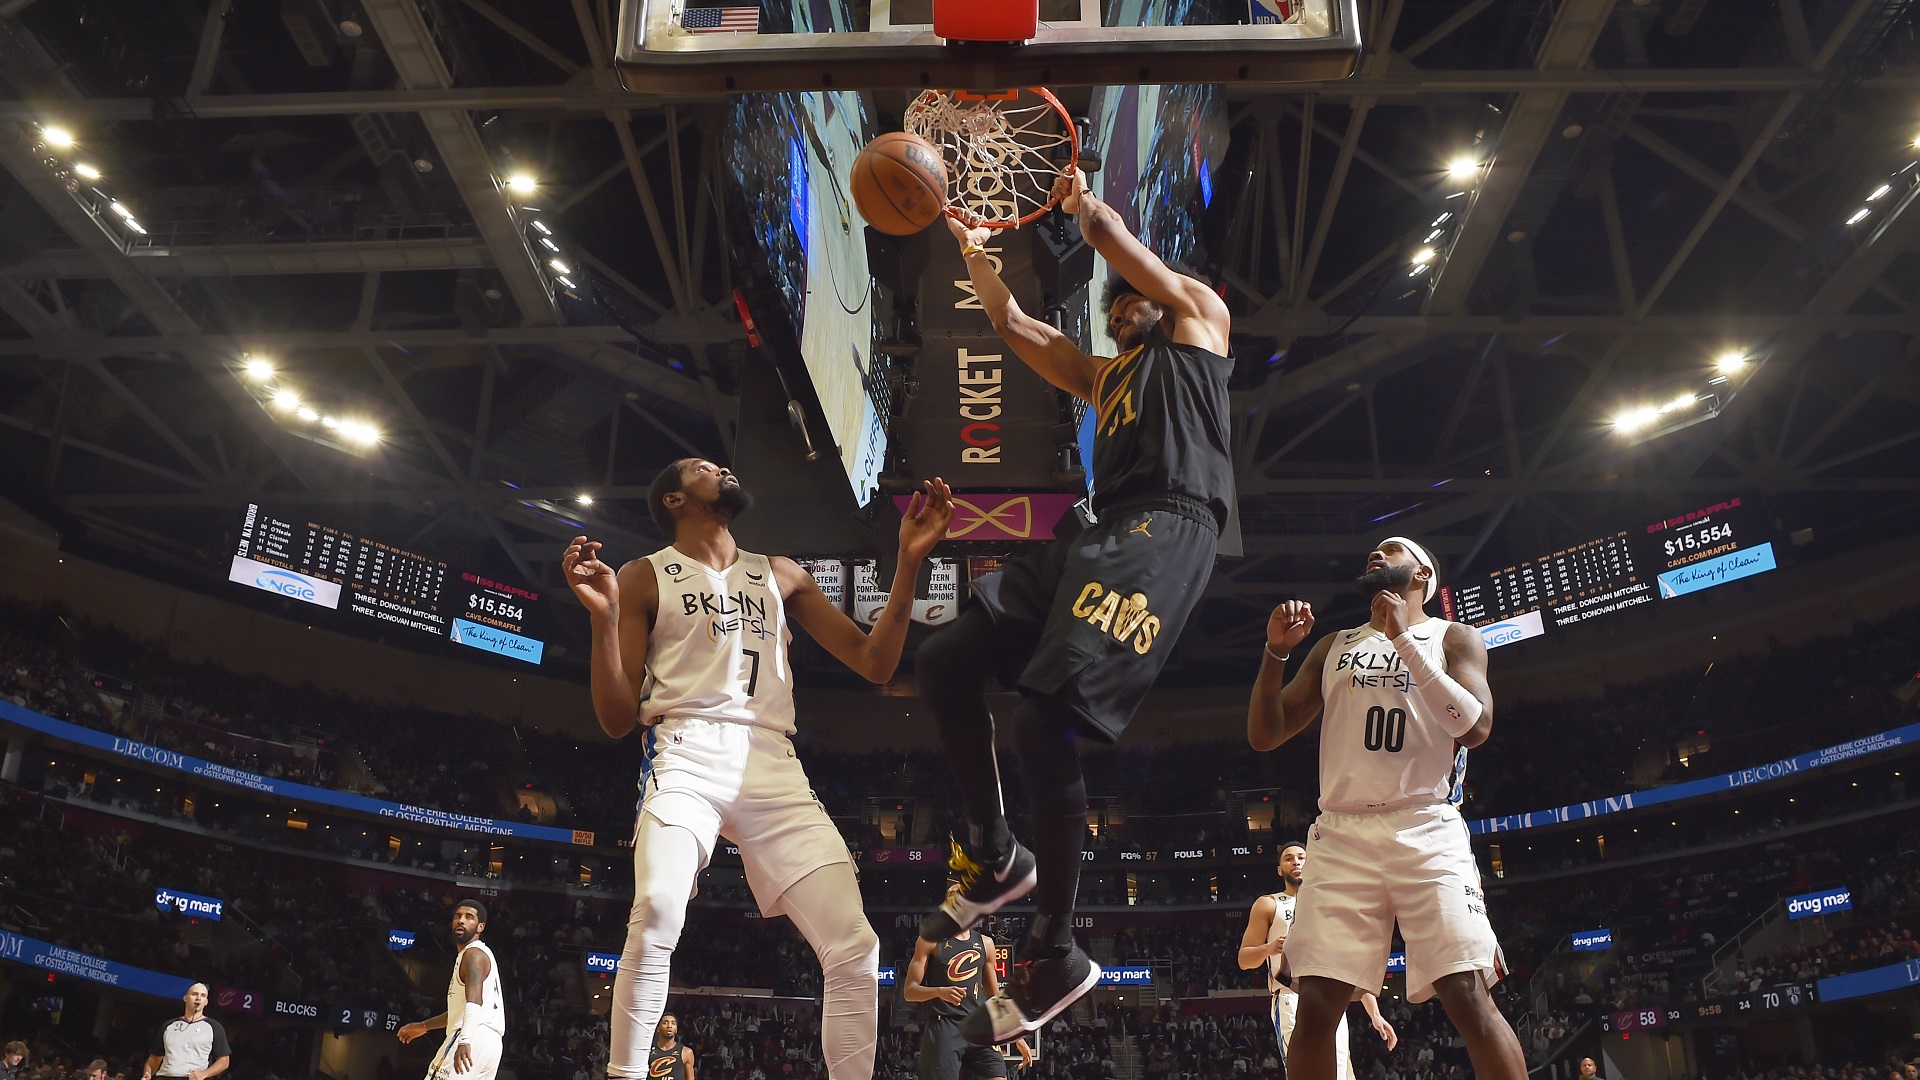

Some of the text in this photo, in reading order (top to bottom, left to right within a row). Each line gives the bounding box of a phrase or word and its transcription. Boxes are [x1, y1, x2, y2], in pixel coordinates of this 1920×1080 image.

[957, 347, 1003, 464] ROCKET
[864, 411, 880, 478] CLIFFS
[1686, 497, 1741, 521] RAFFLE
[237, 503, 258, 557] BROOKLYN NETS
[272, 519, 290, 529] Durant
[267, 540, 283, 550] Irving
[1664, 522, 1733, 556] $15,554
[266, 547, 289, 559] Simmons
[1667, 541, 1738, 568] CAVS.COM/RAFFLE
[253, 553, 294, 570] TEAM TOTALS
[814, 576, 838, 584] STERN
[1671, 572, 1691, 586] The
[1691, 568, 1715, 581] King
[1716, 562, 1727, 579] of
[495, 583, 538, 601] RAFFLE
[858, 594, 890, 602] CHAMPIO
[1579, 592, 1613, 608] DONOVAN
[380, 599, 412, 615] DONOVAN
[468, 593, 523, 621] $15,554
[681, 590, 766, 620] BKLYN
[1581, 604, 1615, 620] DONOVAN
[377, 611, 409, 627] DONOVAN
[465, 612, 522, 633] CAVS.COM/RAFFLE
[1071, 581, 1161, 655] CAVS
[1468, 610, 1486, 620] Garland
[1476, 617, 1496, 628] TOTALS
[463, 626, 478, 638] The
[479, 630, 498, 648] King
[499, 637, 508, 650] of
[742, 649, 760, 698] 7
[1365, 706, 1407, 752] 00
[1809, 736, 1902, 767] OF OSTEOPATHIC MEDICINE
[1820, 733, 1886, 757] LAKE ERIE COLLEGE
[113, 738, 184, 769] LECOM
[193, 766, 274, 792] OF OSTEOPATHIC MEDICINE
[206, 762, 263, 783] LAKE ERIE COLLEGE
[1728, 758, 1799, 787] LECOM
[395, 809, 461, 830] OSTEOPATHIC
[464, 823, 514, 836] MEDICINE
[399, 803, 424, 815] LAKE
[449, 813, 493, 826] COLLEGE
[574, 831, 593, 840] 50/50
[726, 846, 741, 855] TO
[908, 851, 923, 861] 58
[1081, 850, 1095, 861] 70
[1120, 851, 1158, 861] FG% 57
[1174, 849, 1203, 859] FOULS
[1232, 846, 1250, 856] TOL
[190, 901, 222, 915] mart
[1788, 897, 1821, 912] drug
[1573, 936, 1592, 947] drug
[49, 946, 108, 971] LAKE ERIE COLLEGE
[587, 954, 615, 971] drug
[1387, 955, 1406, 967] art
[34, 954, 119, 984] OF OSTEOPATHIC MEDICINE
[877, 969, 894, 980] art
[1100, 968, 1151, 981] rug mart
[1762, 992, 1780, 1009] 70
[1808, 990, 1814, 1001] 1
[242, 994, 253, 1010] 2
[275, 1001, 318, 1017] BLOCKS
[341, 1009, 351, 1024] 2
[1698, 1004, 1722, 1016] 9:58
[1739, 1000, 1751, 1010] 24
[385, 1020, 397, 1031] 57
[1640, 1010, 1680, 1026] 58 3Q
[1603, 1023, 1609, 1032] 0
